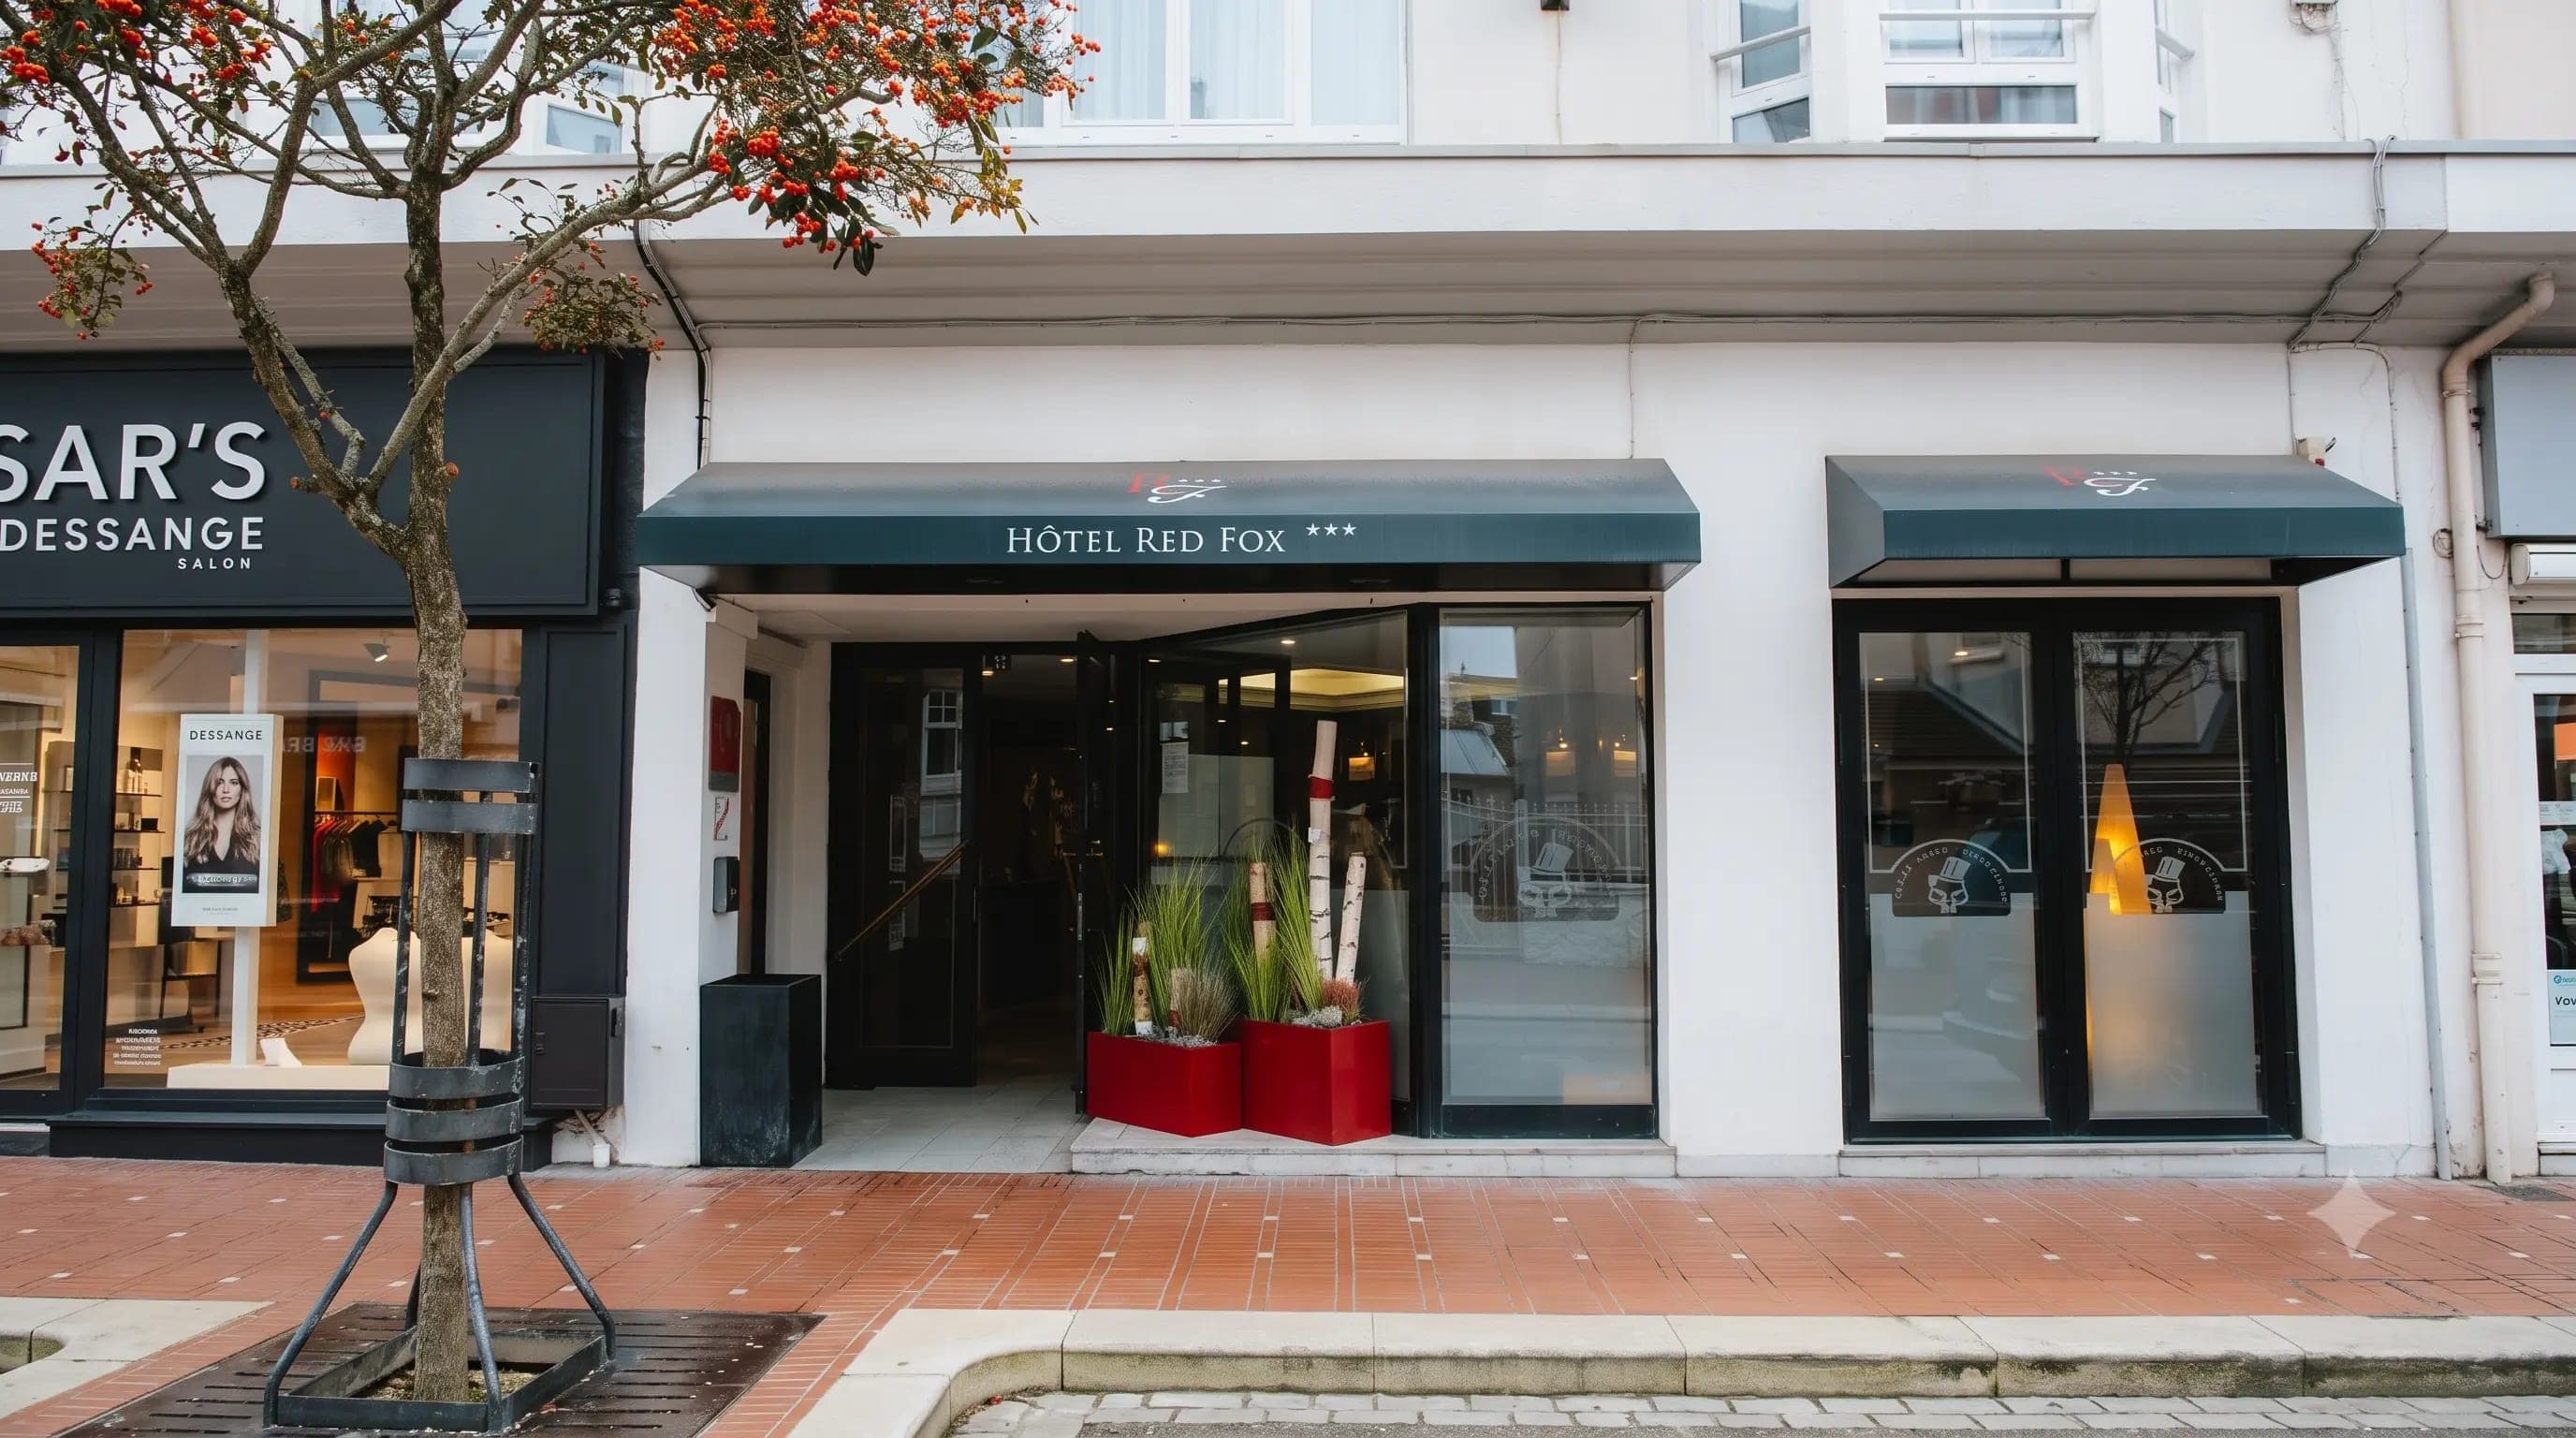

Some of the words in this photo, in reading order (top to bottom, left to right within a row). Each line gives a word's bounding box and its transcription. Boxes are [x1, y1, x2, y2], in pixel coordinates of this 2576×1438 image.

[0, 421, 266, 502] SAR'S
[0, 517, 264, 551] DESSANGE
[1007, 524, 1121, 553] HÔTEL
[1136, 526, 1204, 552] RED
[1220, 526, 1286, 552] FOX
[177, 557, 252, 569] SALON
[189, 730, 263, 741] DESSANGE
